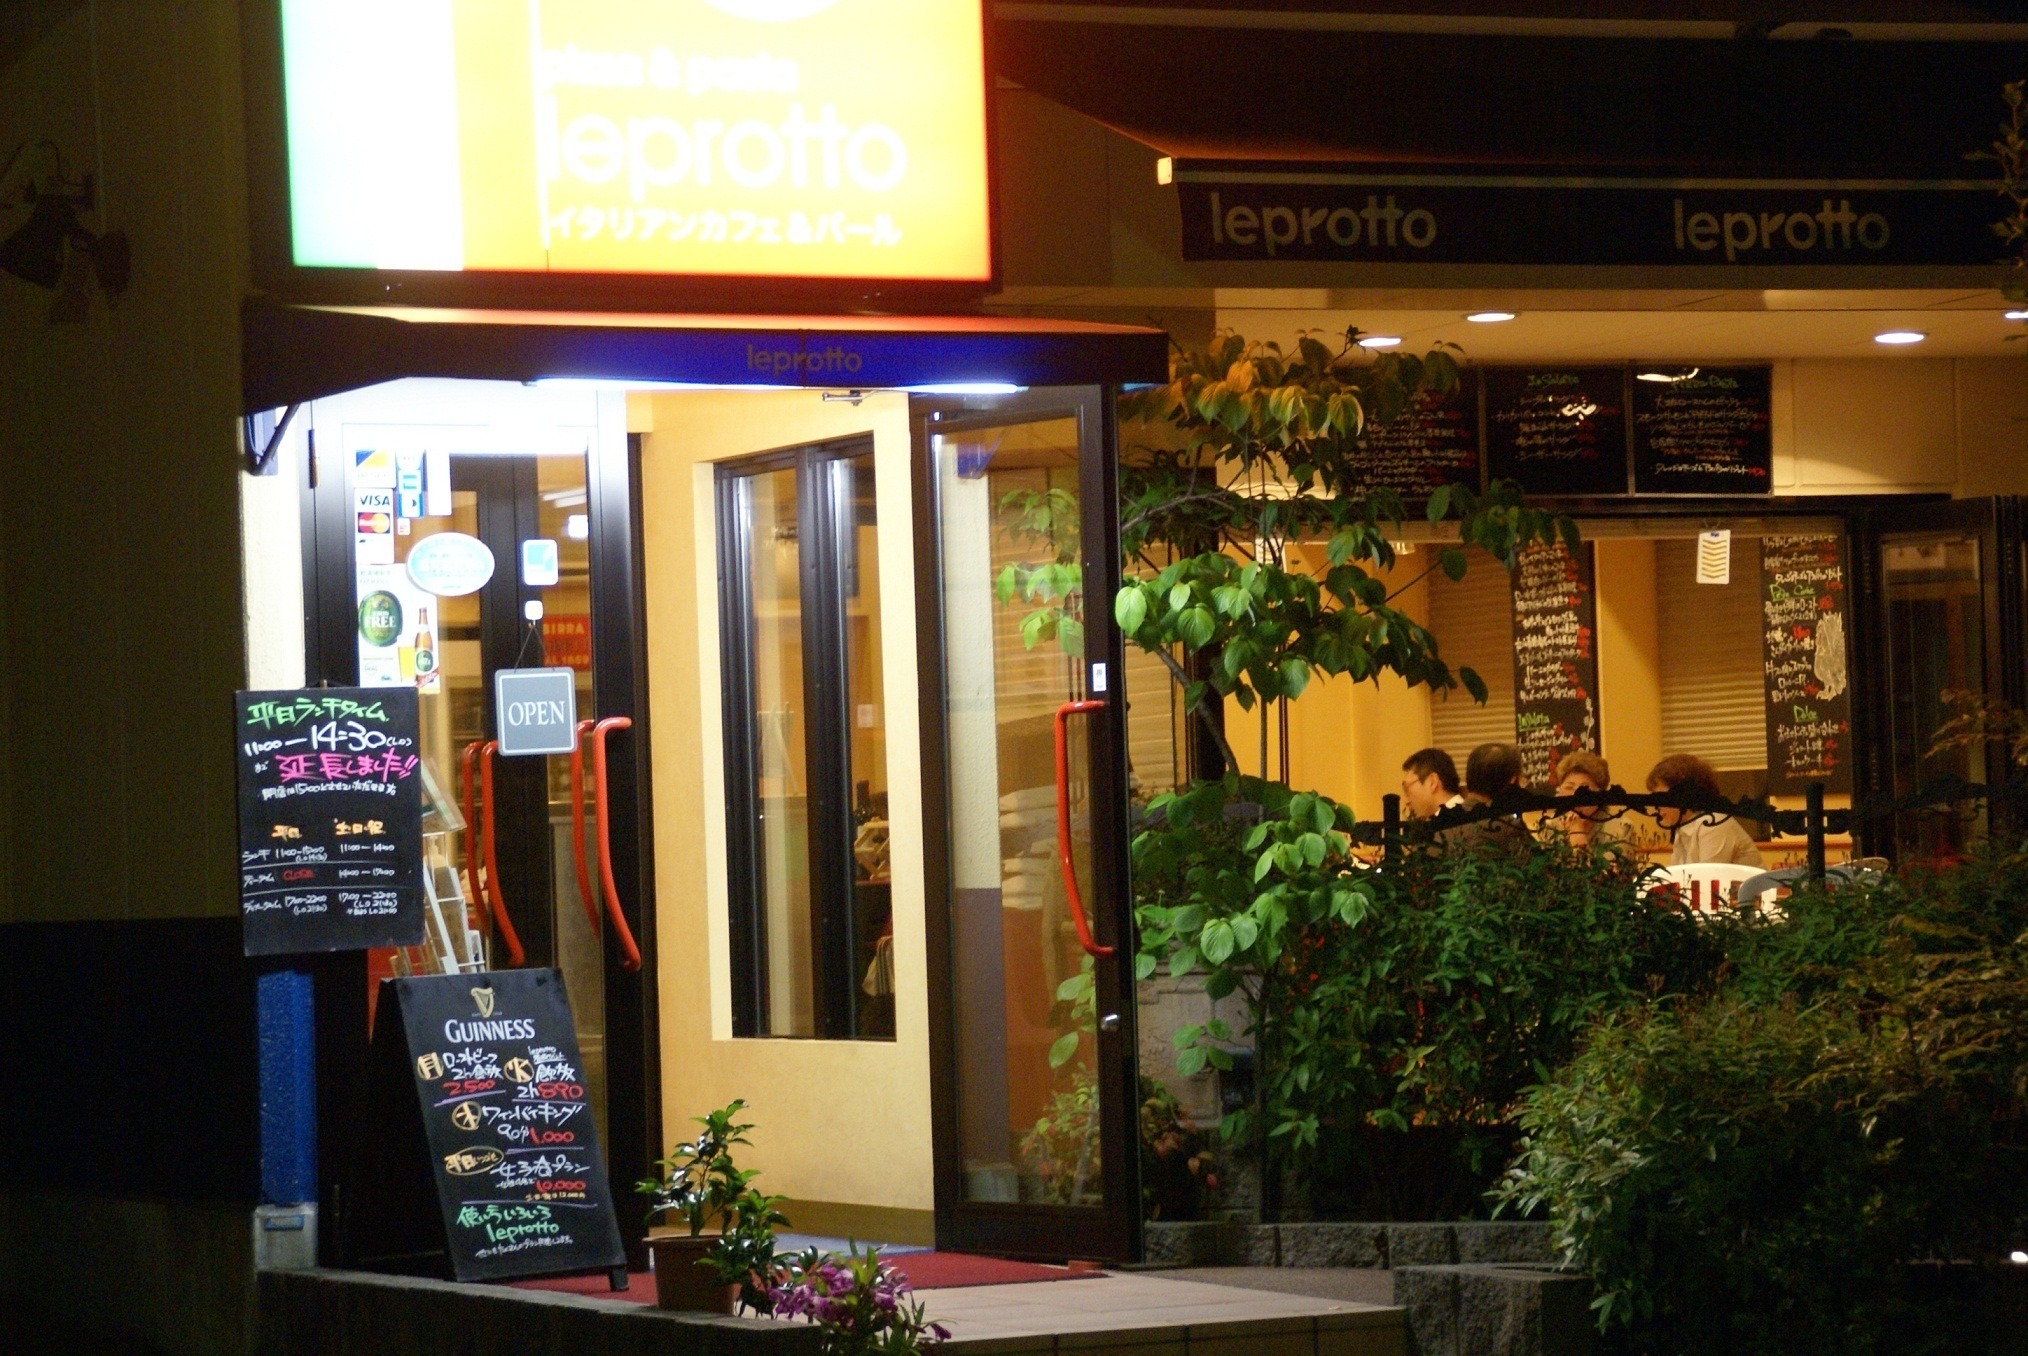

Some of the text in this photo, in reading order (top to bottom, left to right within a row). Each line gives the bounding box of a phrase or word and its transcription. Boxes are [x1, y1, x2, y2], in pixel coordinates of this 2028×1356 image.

[544, 93, 908, 203] leprotto
[1210, 192, 1437, 256] leprotto
[1674, 199, 1890, 262] leprotto
[747, 344, 863, 376] leprotto
[360, 495, 391, 506] VISA
[364, 615, 397, 628] FREE
[507, 699, 566, 727] OPEN
[445, 1018, 536, 1043] GUINNESS
[417, 1052, 442, 1080] 月
[485, 1221, 560, 1244] leprotto
